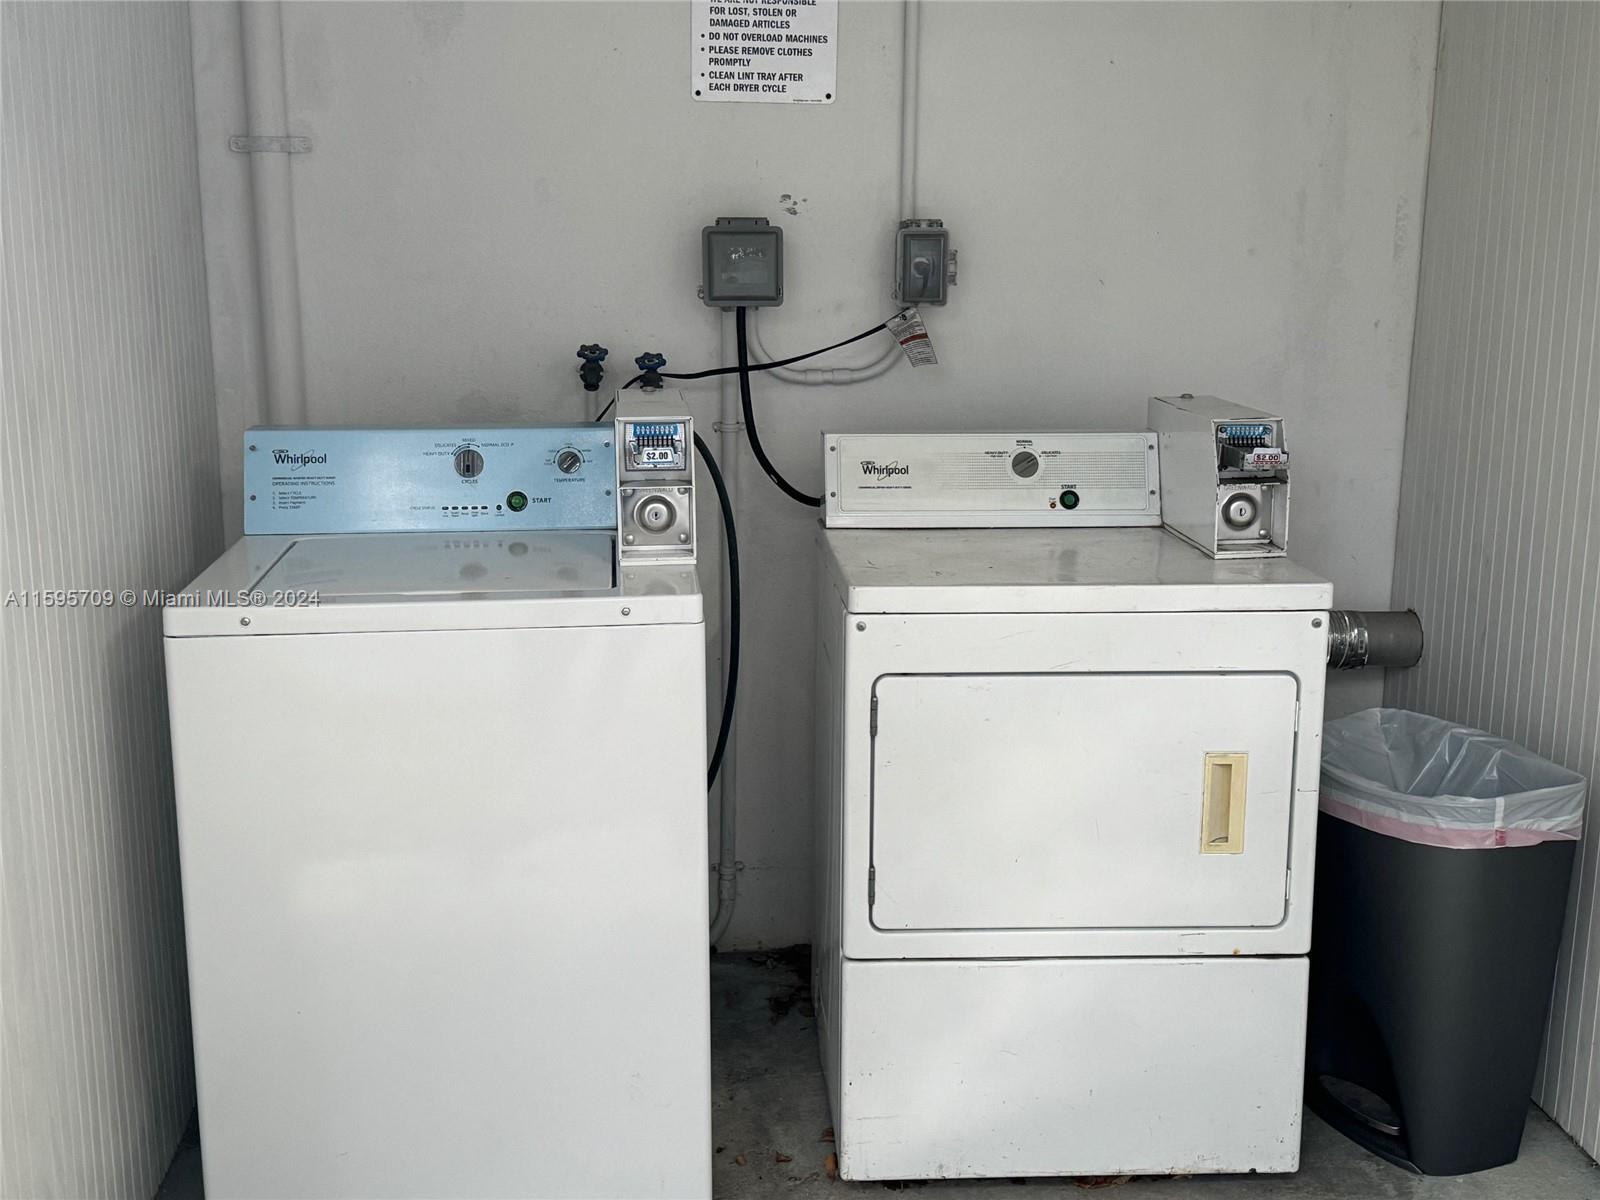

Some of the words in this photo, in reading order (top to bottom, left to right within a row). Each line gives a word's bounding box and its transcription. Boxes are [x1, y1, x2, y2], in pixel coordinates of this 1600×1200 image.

[710, 6, 726, 15] FOR
[728, 7, 750, 17] LOST,
[752, 8, 782, 17] STOLEN
[786, 8, 797, 17] OR
[710, 18, 750, 28] DAMAGED
[752, 20, 790, 29] ARTICLES
[709, 32, 720, 40] DO
[723, 32, 739, 41] NOT
[741, 33, 783, 42] OVERLOAD
[786, 34, 828, 44] MACHINES
[709, 46, 739, 54] PLEASE
[742, 46, 775, 55] REMOVE
[777, 48, 813, 56] CLOTHES
[709, 58, 751, 67] PROMPTLY
[709, 71, 735, 80] CLEAN
[738, 72, 754, 80] LINT
[757, 72, 777, 81] TRAY
[778, 73, 803, 82] AFTER
[709, 83, 730, 91] EACH
[733, 84, 759, 92] DRYER
[762, 84, 786, 93] CYCLE
[273, 452, 327, 468] Whirlpool
[646, 452, 668, 461] $2.00
[862, 465, 909, 477] Whirlpool
